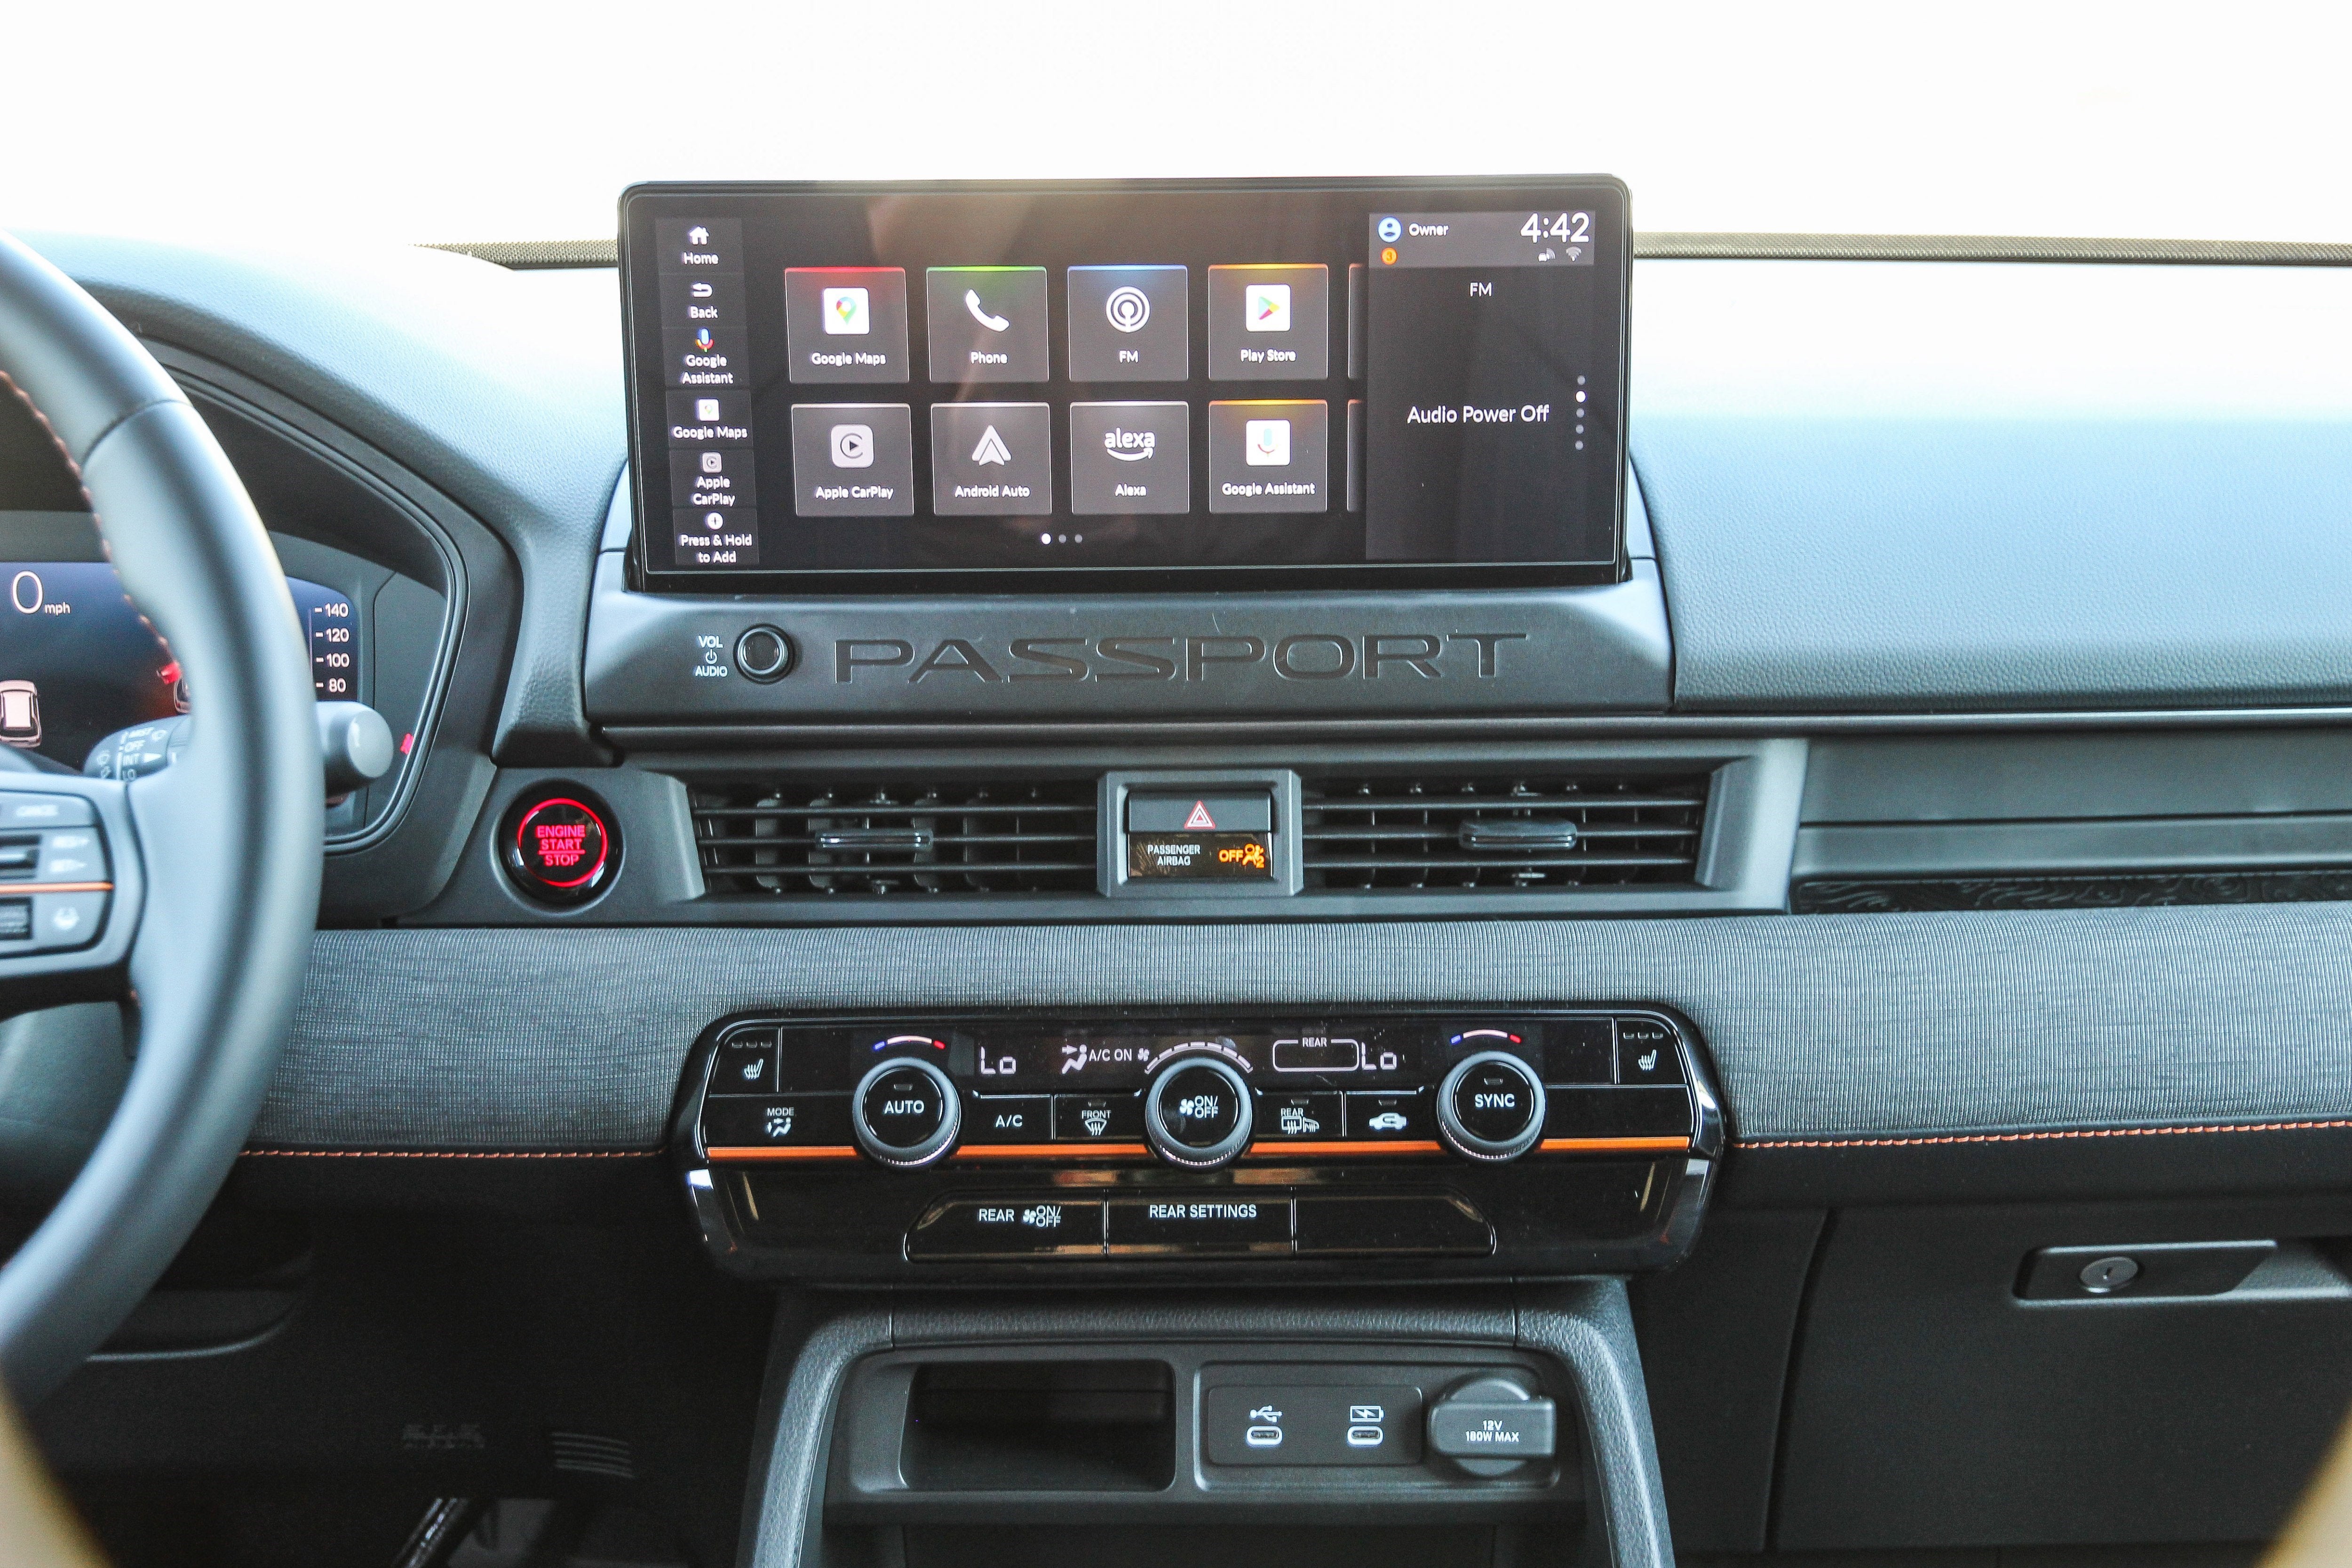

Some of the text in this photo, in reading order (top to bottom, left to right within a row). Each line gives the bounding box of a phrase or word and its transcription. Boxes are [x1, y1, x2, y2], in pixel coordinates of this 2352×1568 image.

[1409, 212, 1590, 243] Owner 4:42
[683, 252, 719, 265] Home
[1470, 283, 1492, 296] FM
[690, 306, 718, 319] Back
[685, 354, 727, 368] Google
[811, 352, 886, 367] Google Maps
[970, 351, 1008, 366] Phone
[1119, 350, 1139, 363] FM
[1240, 349, 1296, 364] Play Store
[681, 372, 733, 384] Assistant
[1407, 404, 1550, 424] Audio Power Off
[673, 426, 748, 440] Google Maps
[1104, 428, 1156, 449] alexa
[697, 476, 730, 490] Apple
[1222, 482, 1316, 497] Google Assistant
[815, 486, 894, 500] Apple CarPlay
[954, 484, 1030, 498] Android Auto
[1115, 484, 1147, 497] Alexa
[693, 493, 736, 506] CarPlay
[681, 534, 752, 547] Press & Hold
[698, 551, 737, 563] to Add
[12, 570, 71, 616] 0 mph
[325, 603, 349, 617] 140
[326, 628, 350, 642] 120
[698, 635, 723, 649] VOL
[327, 653, 350, 668] 100
[834, 633, 1527, 684] PASSPORT
[695, 666, 727, 678] AUDIO
[329, 678, 346, 692] 80
[536, 825, 586, 838] ENGINE
[540, 838, 582, 850] START
[1147, 844, 1243, 862] PASSENGER OFF
[545, 854, 580, 866] STOP
[1157, 856, 1191, 866] AIRBAG
[1302, 1038, 1327, 1047] REAR
[980, 1047, 1016, 1074] Lo
[1089, 1049, 1132, 1062] A/C ON
[1362, 1043, 1397, 1070] Lo
[884, 1101, 925, 1114] AUTO
[1475, 1094, 1515, 1108] SYNC
[767, 1107, 794, 1116] MODE
[1081, 1110, 1111, 1119] FRONT
[1194, 1106, 1218, 1118] OFF
[995, 1115, 1022, 1127] A/C
[978, 1209, 1014, 1221] REAR
[1150, 1204, 1256, 1218] REAR SETTINGS
[1036, 1216, 1061, 1227] OFF
[1483, 1420, 1503, 1431] 12V
[1495, 1431, 1520, 1442] MAX
